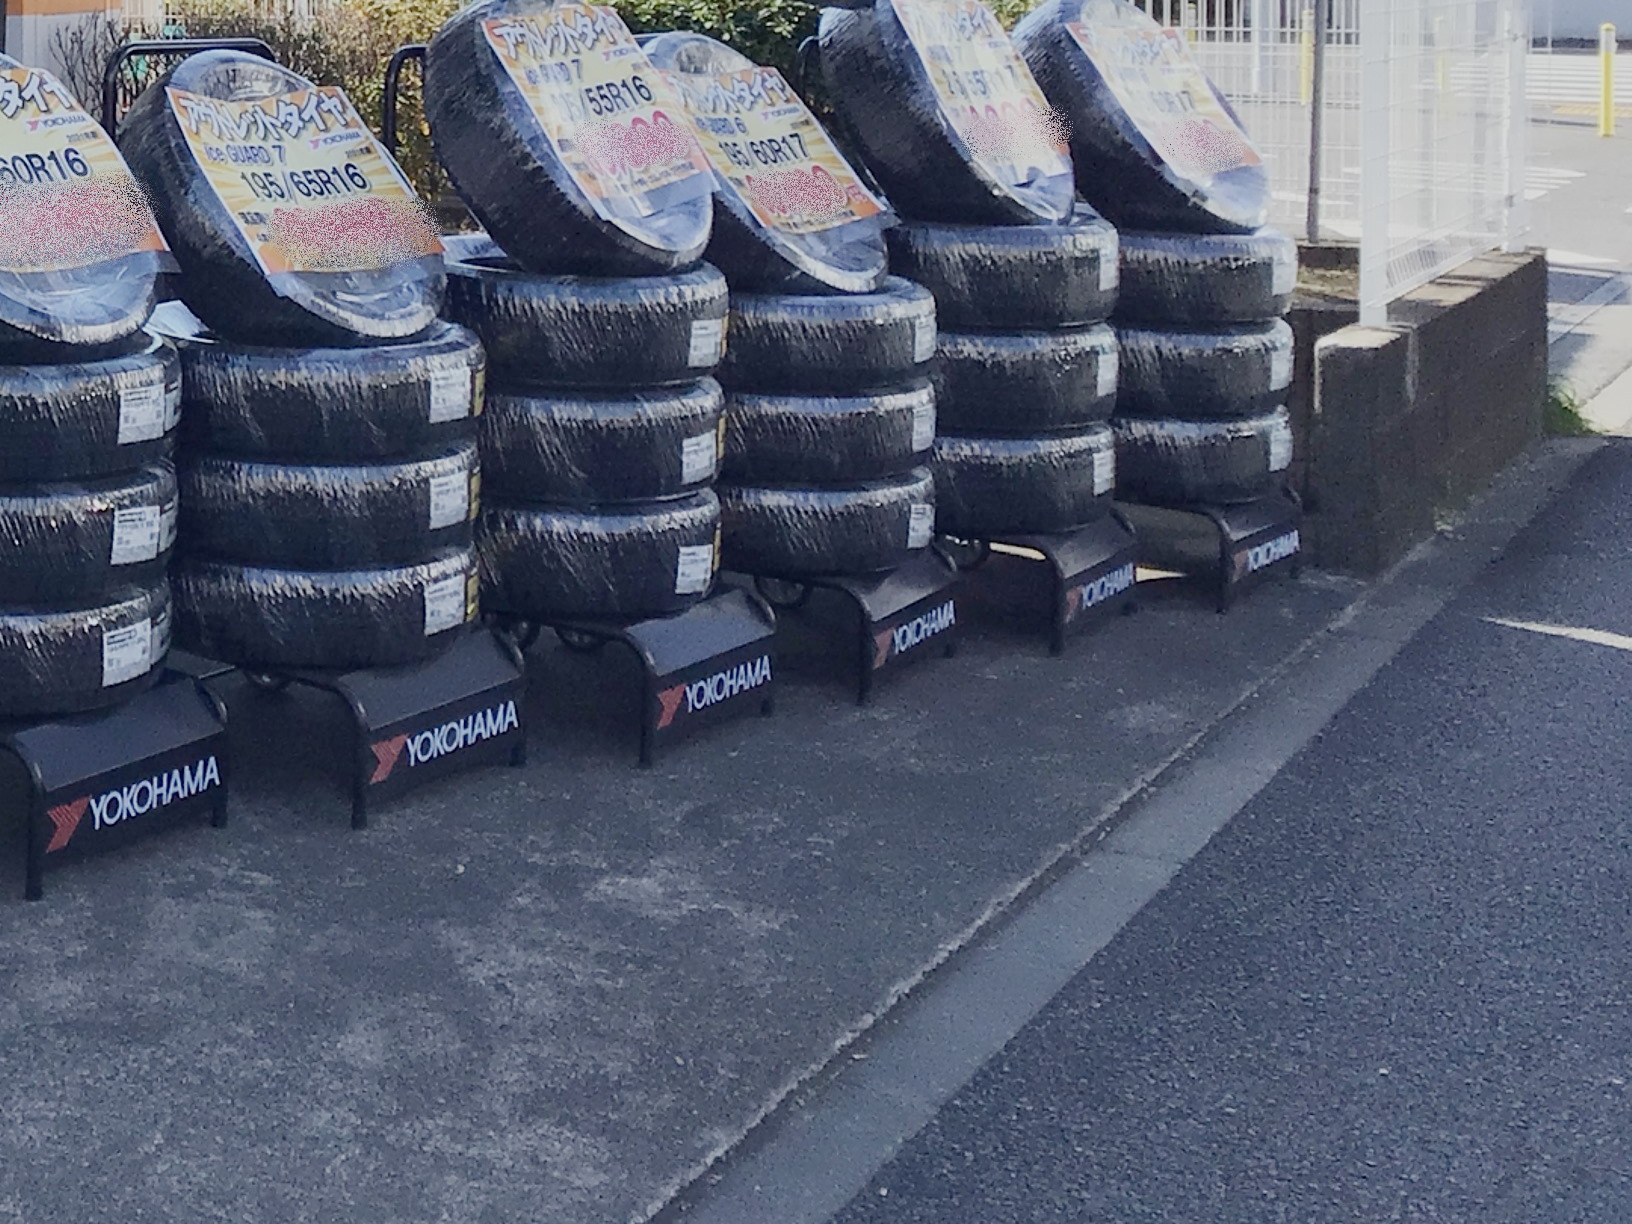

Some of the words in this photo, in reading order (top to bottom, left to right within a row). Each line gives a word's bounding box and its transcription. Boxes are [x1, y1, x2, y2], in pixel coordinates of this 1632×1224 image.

[240, 163, 368, 200] 195/65R16
[892, 599, 956, 654] YOKOHAMA
[685, 656, 772, 714] YOKOHAMA
[405, 699, 519, 767] YOKOHAMA
[89, 755, 221, 831] YOKOHAMA
